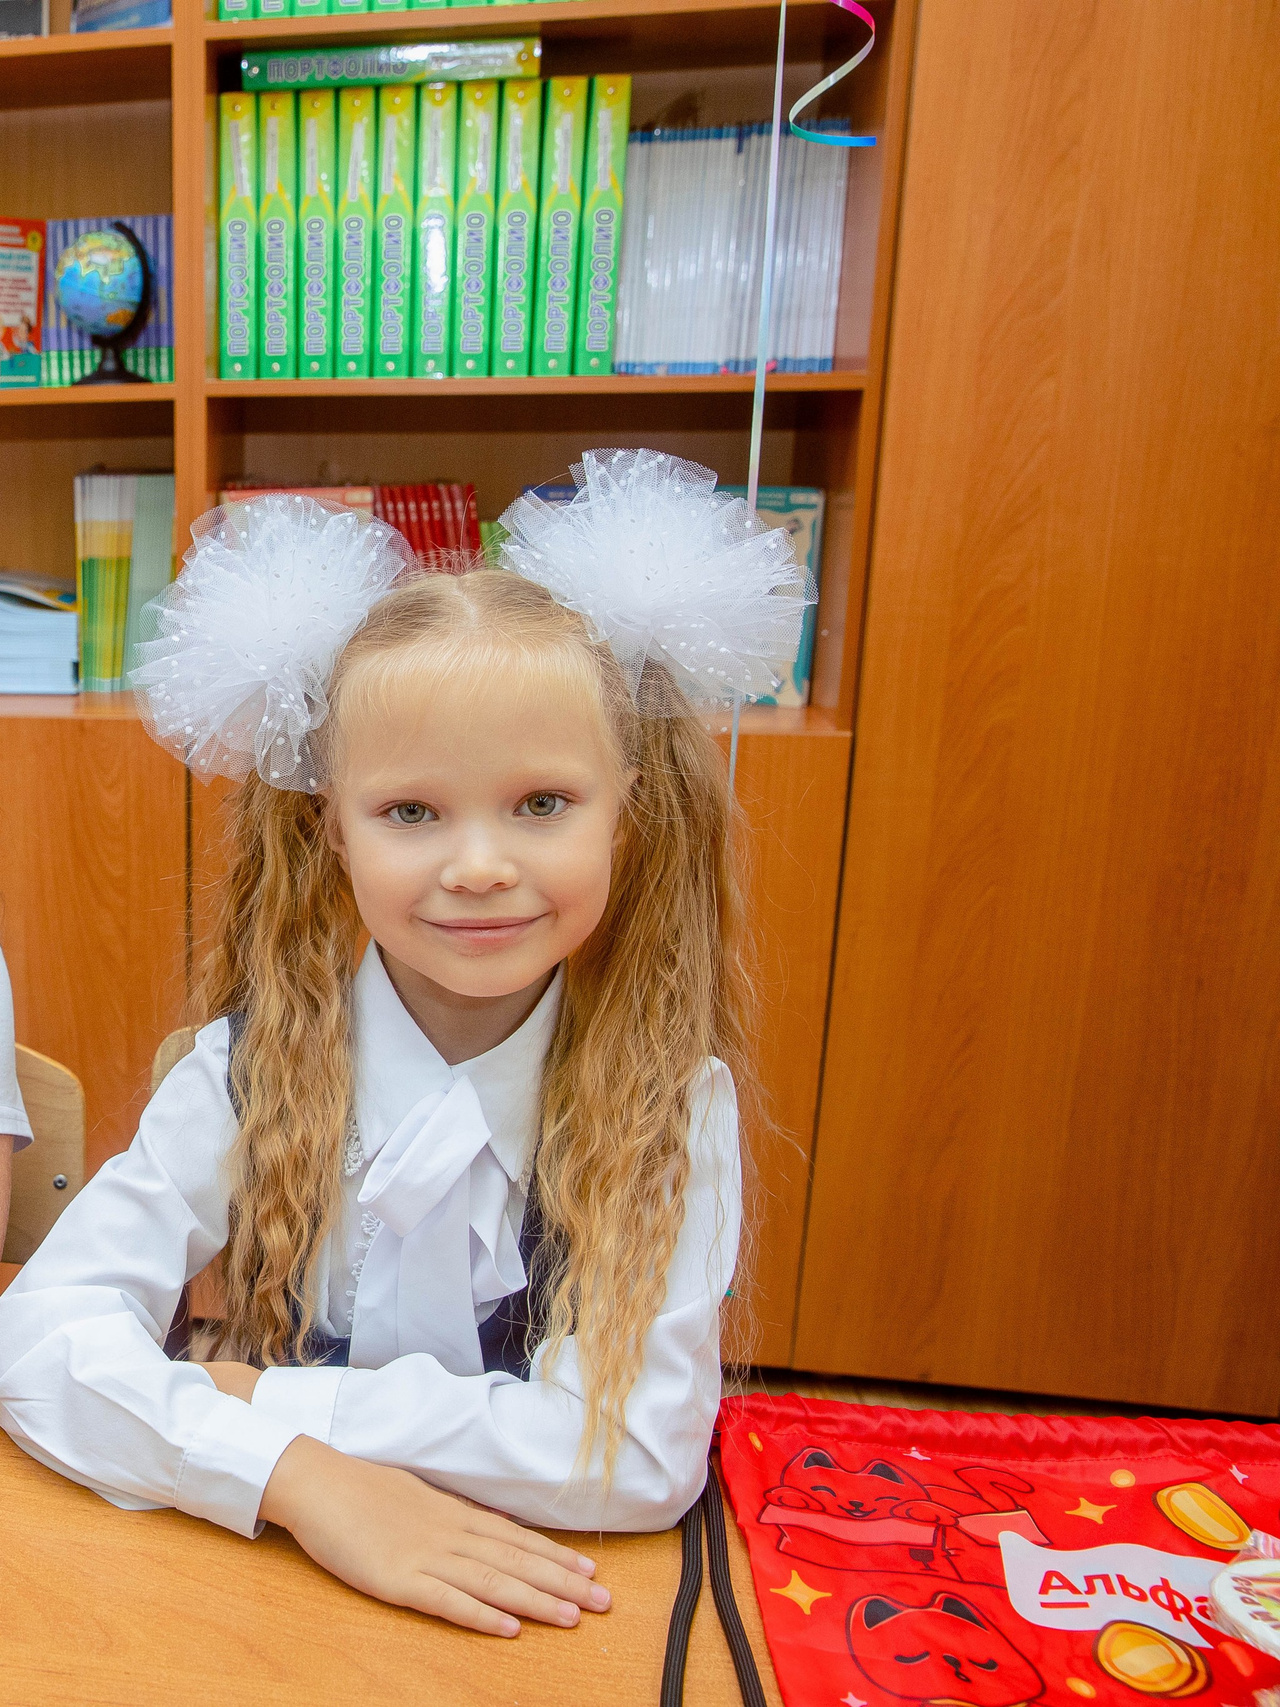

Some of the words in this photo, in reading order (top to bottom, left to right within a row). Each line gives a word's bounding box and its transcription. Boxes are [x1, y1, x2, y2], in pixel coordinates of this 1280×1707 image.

[267, 55, 408, 82] ПОРТФОЛИО
[227, 218, 248, 355] ПОРТФОЛИО
[265, 217, 286, 355] ПОРТФОЛИО
[305, 216, 325, 355] ПОРТФОЛИО
[342, 215, 363, 354] ПОРТФОЛИО
[381, 214, 403, 354] ПОРТФОЛИО
[461, 212, 485, 352] ПОРТФОЛИО
[501, 211, 527, 352] ПОРТФОЛИО
[545, 210, 572, 352] ПОРТФОЛИО
[586, 208, 615, 351] ПОРТФОЛИО
